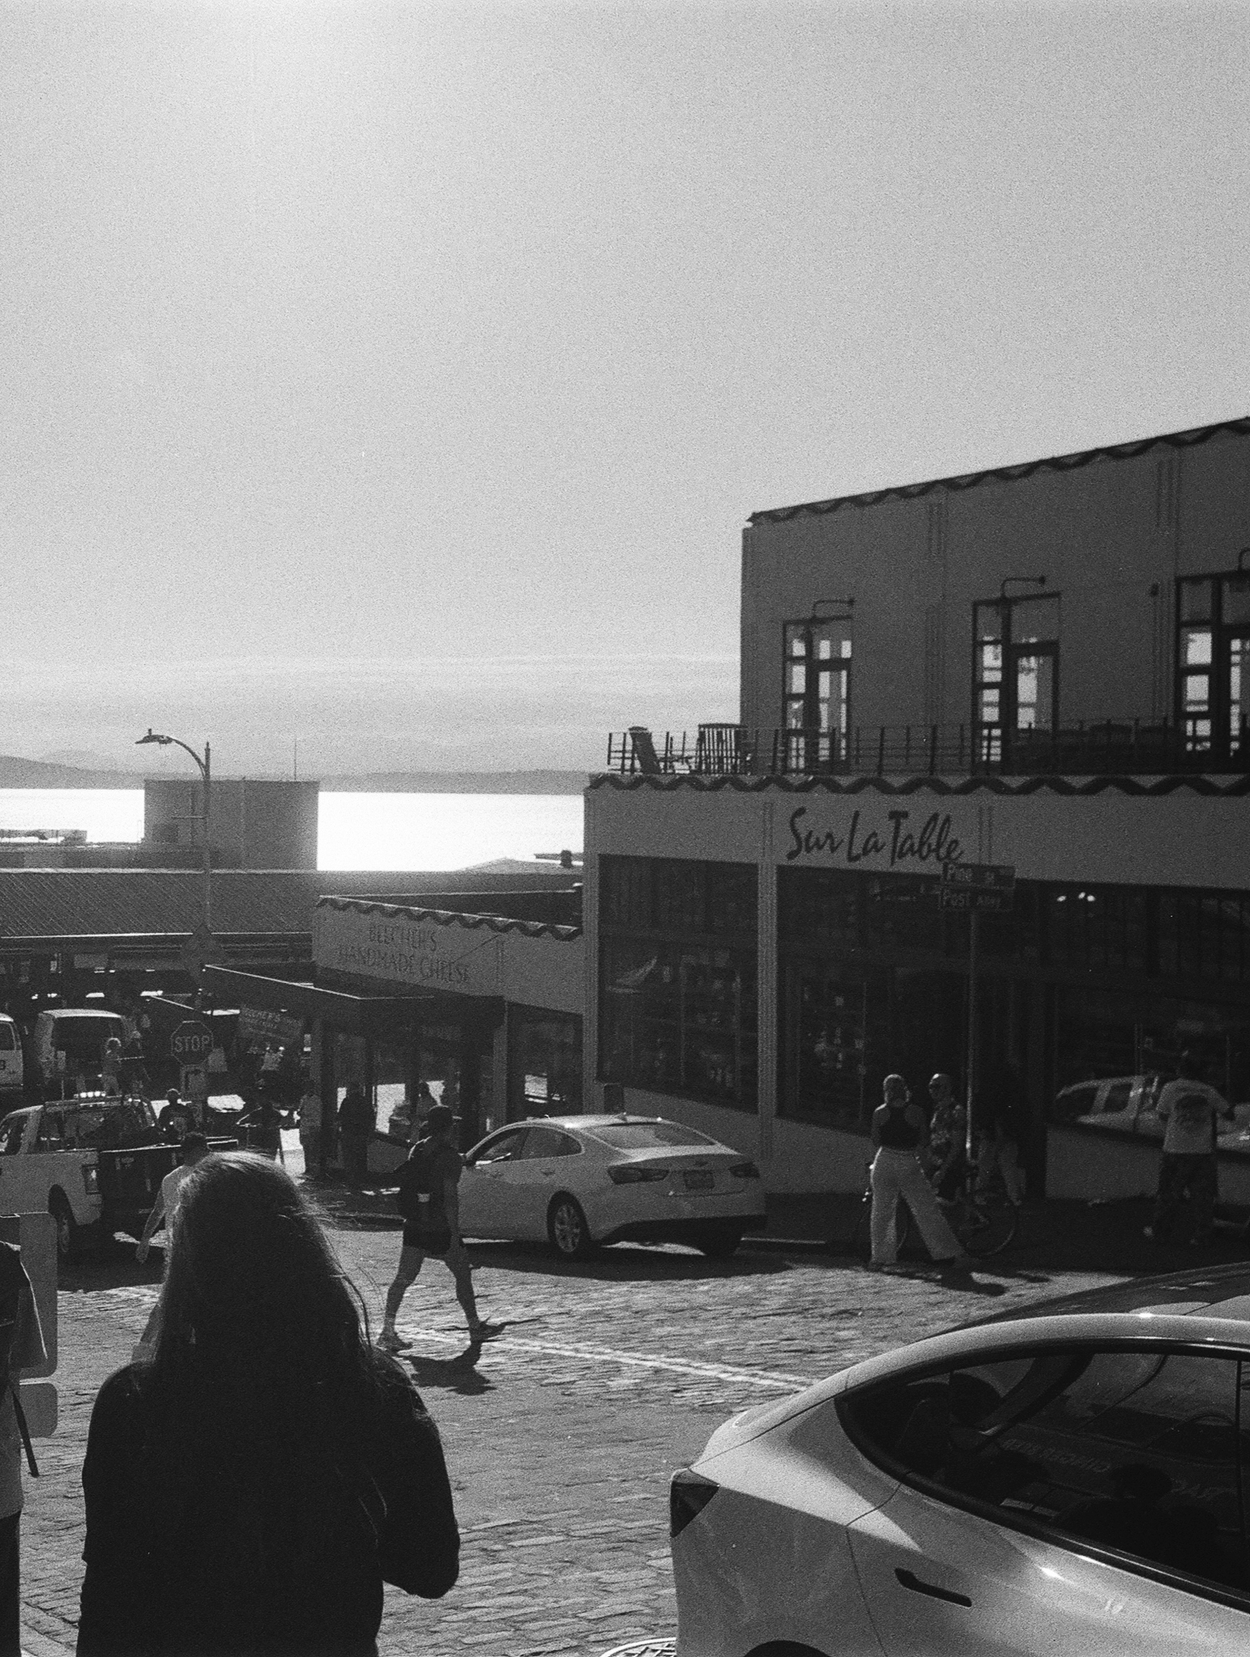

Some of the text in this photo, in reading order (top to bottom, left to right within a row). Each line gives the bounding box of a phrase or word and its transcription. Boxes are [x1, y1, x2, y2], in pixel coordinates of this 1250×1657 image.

[786, 806, 965, 868] Sur La Table
[942, 888, 971, 907] Post
[337, 943, 472, 986] HANDMADE CHEESE
[174, 1035, 211, 1053] STOP
